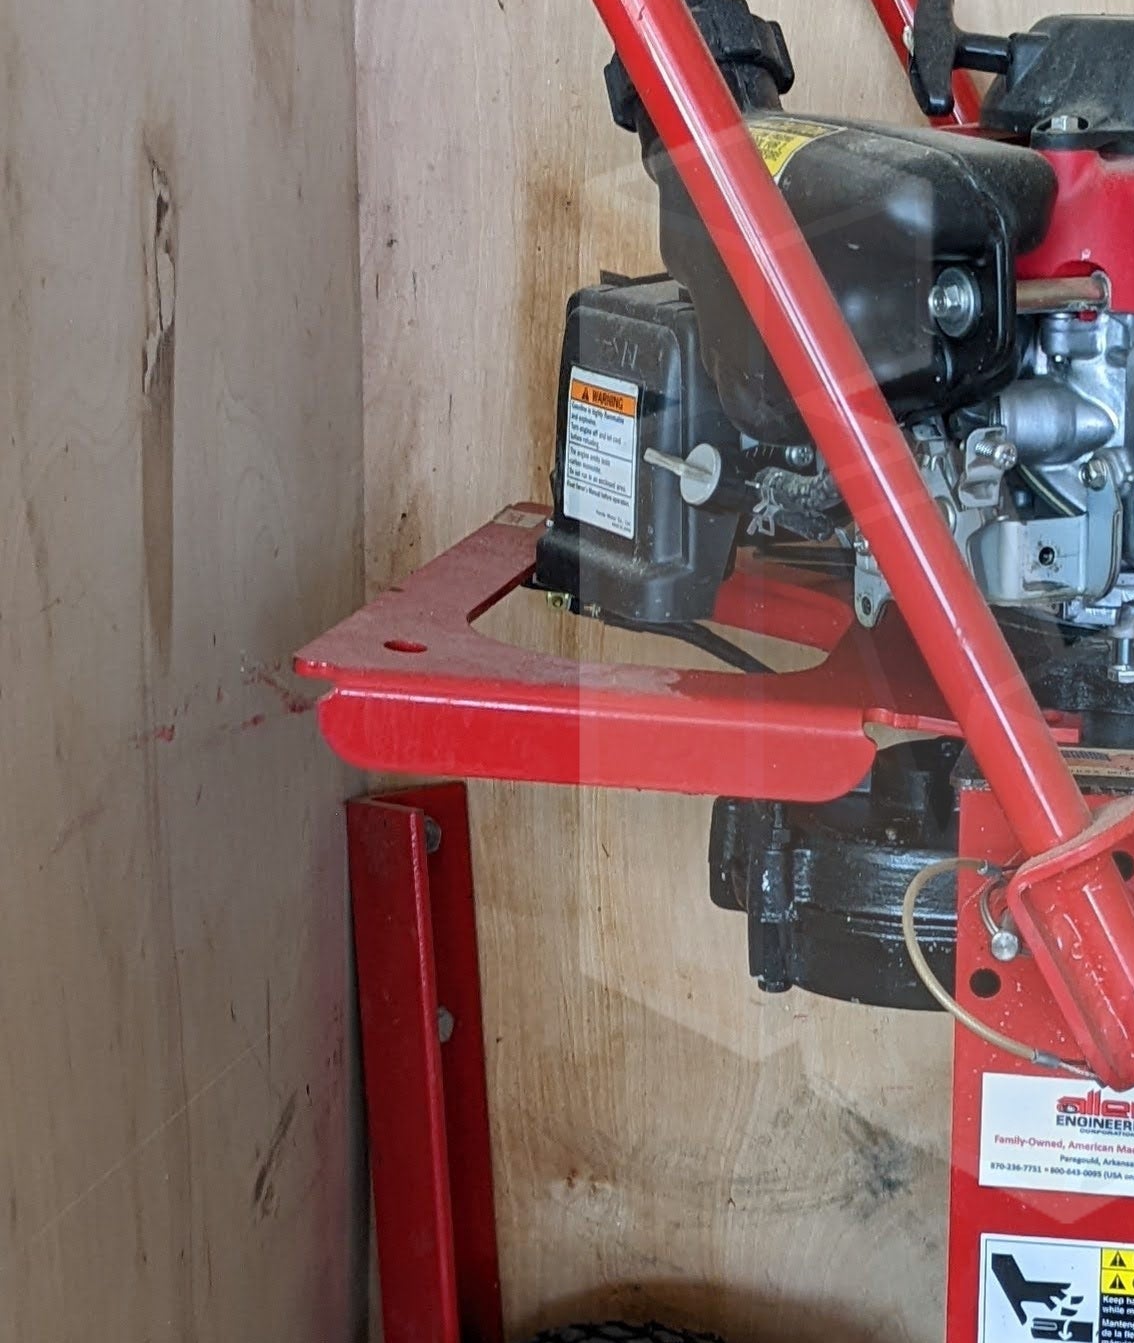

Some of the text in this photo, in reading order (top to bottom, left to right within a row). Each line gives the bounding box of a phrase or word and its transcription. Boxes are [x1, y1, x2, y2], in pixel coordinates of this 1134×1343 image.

[592, 389, 623, 410] WARNING
[994, 1134, 1066, 1150] Family-Owned,
[1067, 1140, 1113, 1152] American
[1059, 1154, 1101, 1165] Paragould,
[1103, 1171, 1122, 1180] (USA
[1102, 1295, 1123, 1305] Keep
[1102, 1305, 1124, 1314] while
